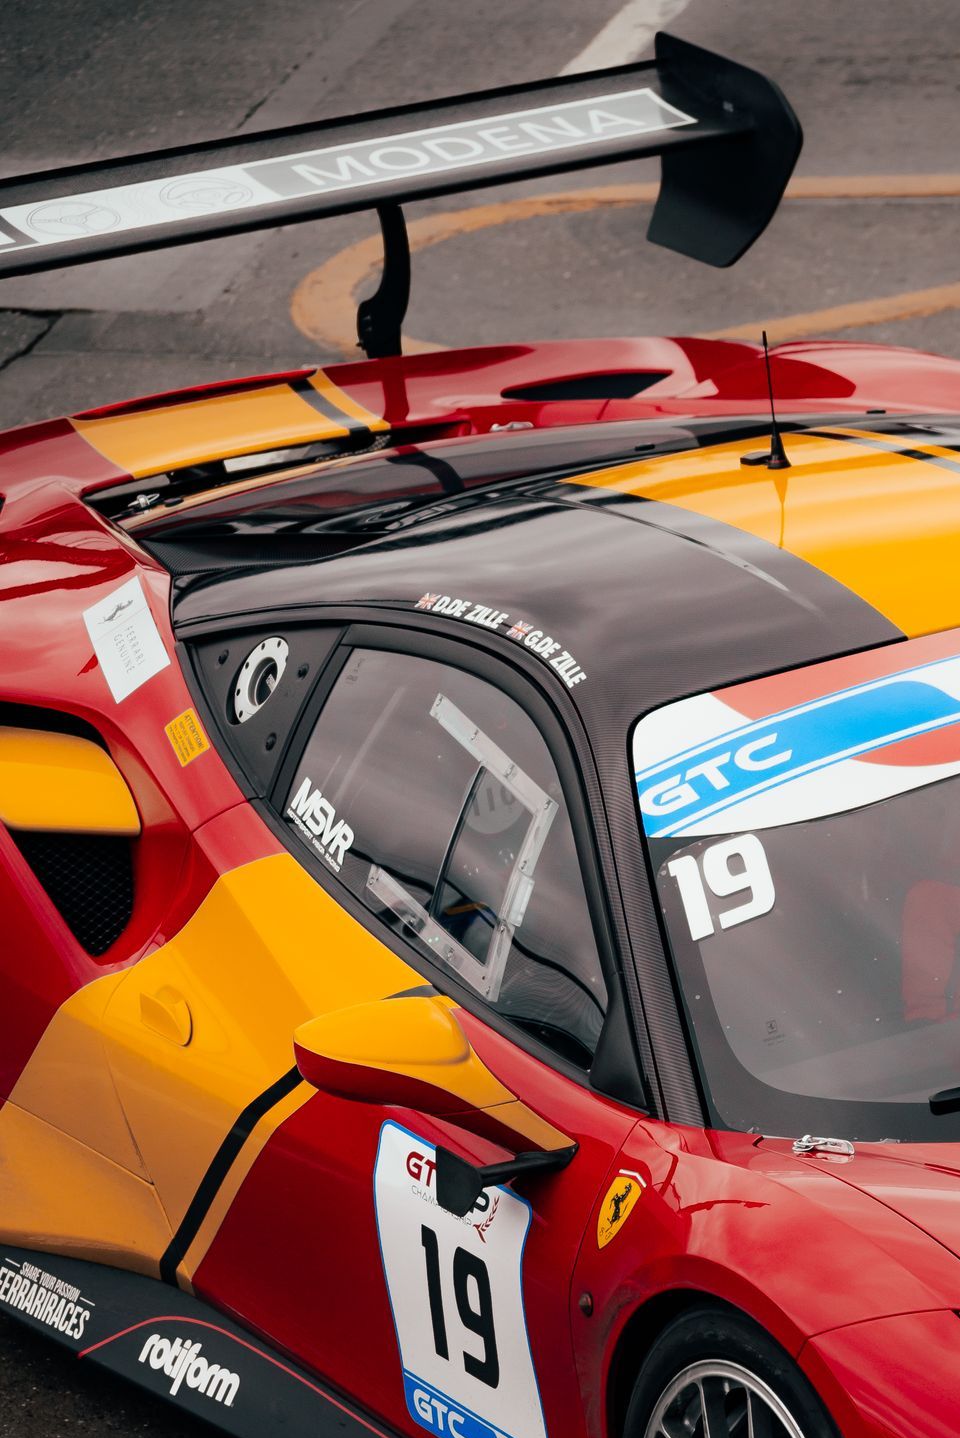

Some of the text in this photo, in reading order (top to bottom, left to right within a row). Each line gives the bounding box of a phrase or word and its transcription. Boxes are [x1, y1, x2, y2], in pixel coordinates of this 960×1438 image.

[290, 108, 648, 187] MODENA
[127, 624, 145, 665] FERRARI
[432, 595, 509, 630] D.DE ZILLE
[113, 633, 135, 674] GENUINE
[524, 630, 587, 689] G.DE ZILLE
[638, 732, 794, 817] GTC
[290, 776, 355, 866] MSVR
[667, 833, 776, 941] 19
[406, 1151, 490, 1214] GTP
[20, 1261, 81, 1303] SHARE YOUR PASSION
[421, 1223, 500, 1390] 19
[138, 1333, 241, 1406] rotiform
